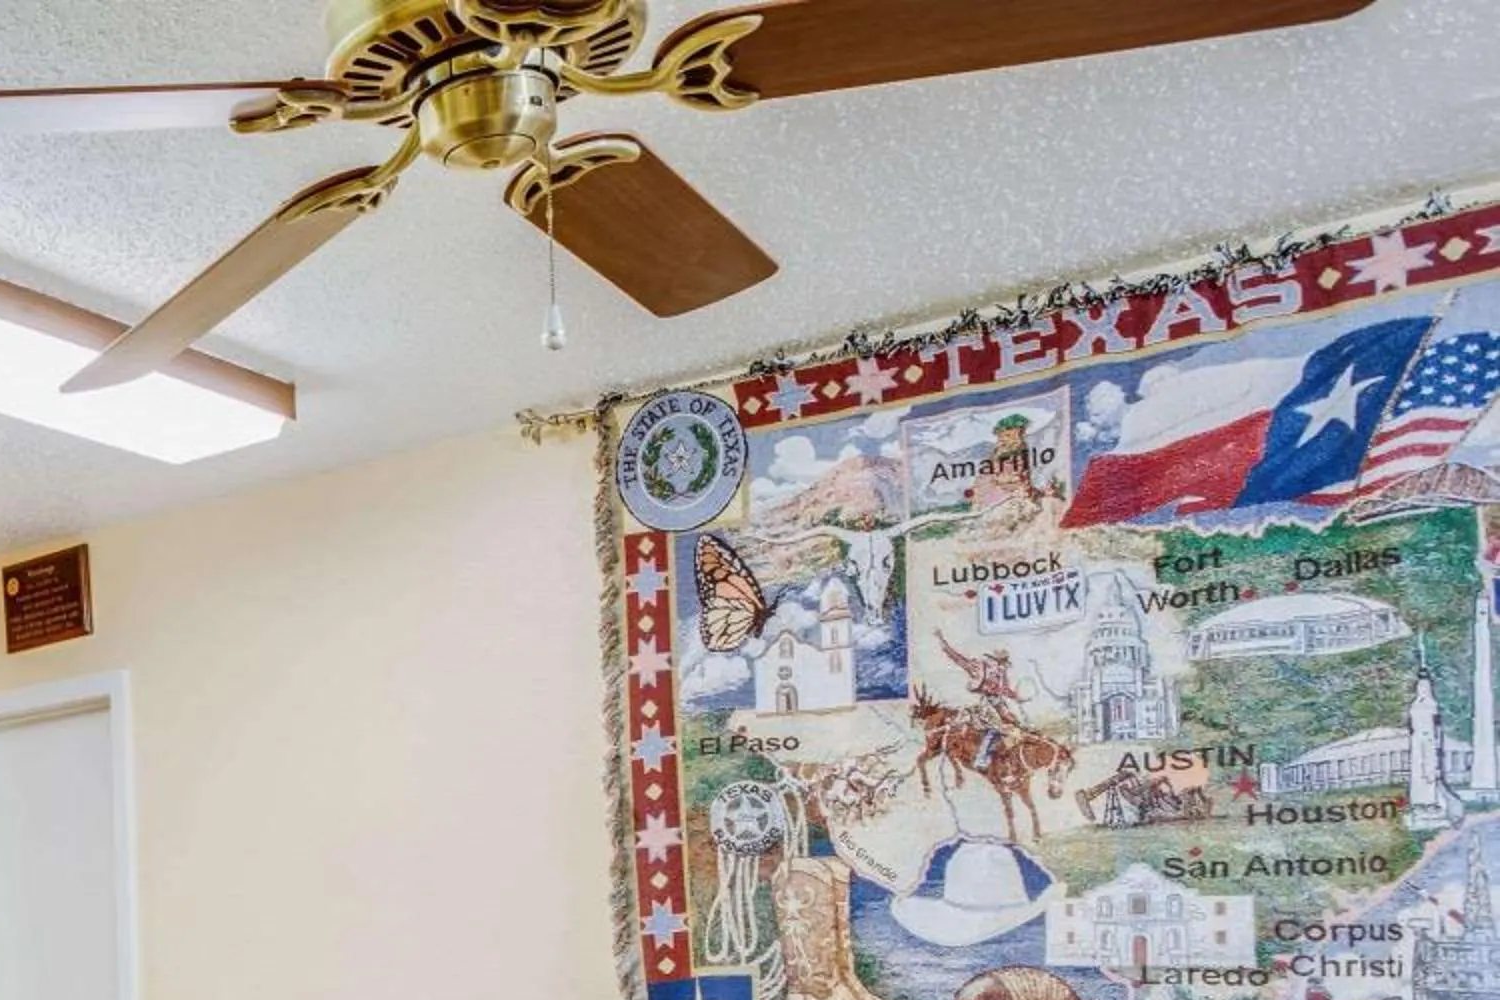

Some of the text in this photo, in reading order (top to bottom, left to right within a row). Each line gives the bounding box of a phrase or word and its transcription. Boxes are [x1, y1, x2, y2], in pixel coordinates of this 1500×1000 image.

[918, 263, 1304, 389] TEXAS
[623, 398, 742, 489] THE STATE OF TEXAS
[930, 446, 1056, 485] Amarillo
[932, 551, 1062, 587] Lubbock
[1293, 543, 1402, 581] Dallas
[1134, 546, 1241, 616] Fort Worth
[699, 735, 799, 755] El Paso
[1114, 744, 1257, 772] AUSTIN
[1247, 799, 1398, 827] Houston
[1163, 853, 1387, 878] San Antonio
[1275, 919, 1404, 980] Corpus Christi
[1140, 964, 1270, 988] Laredo
